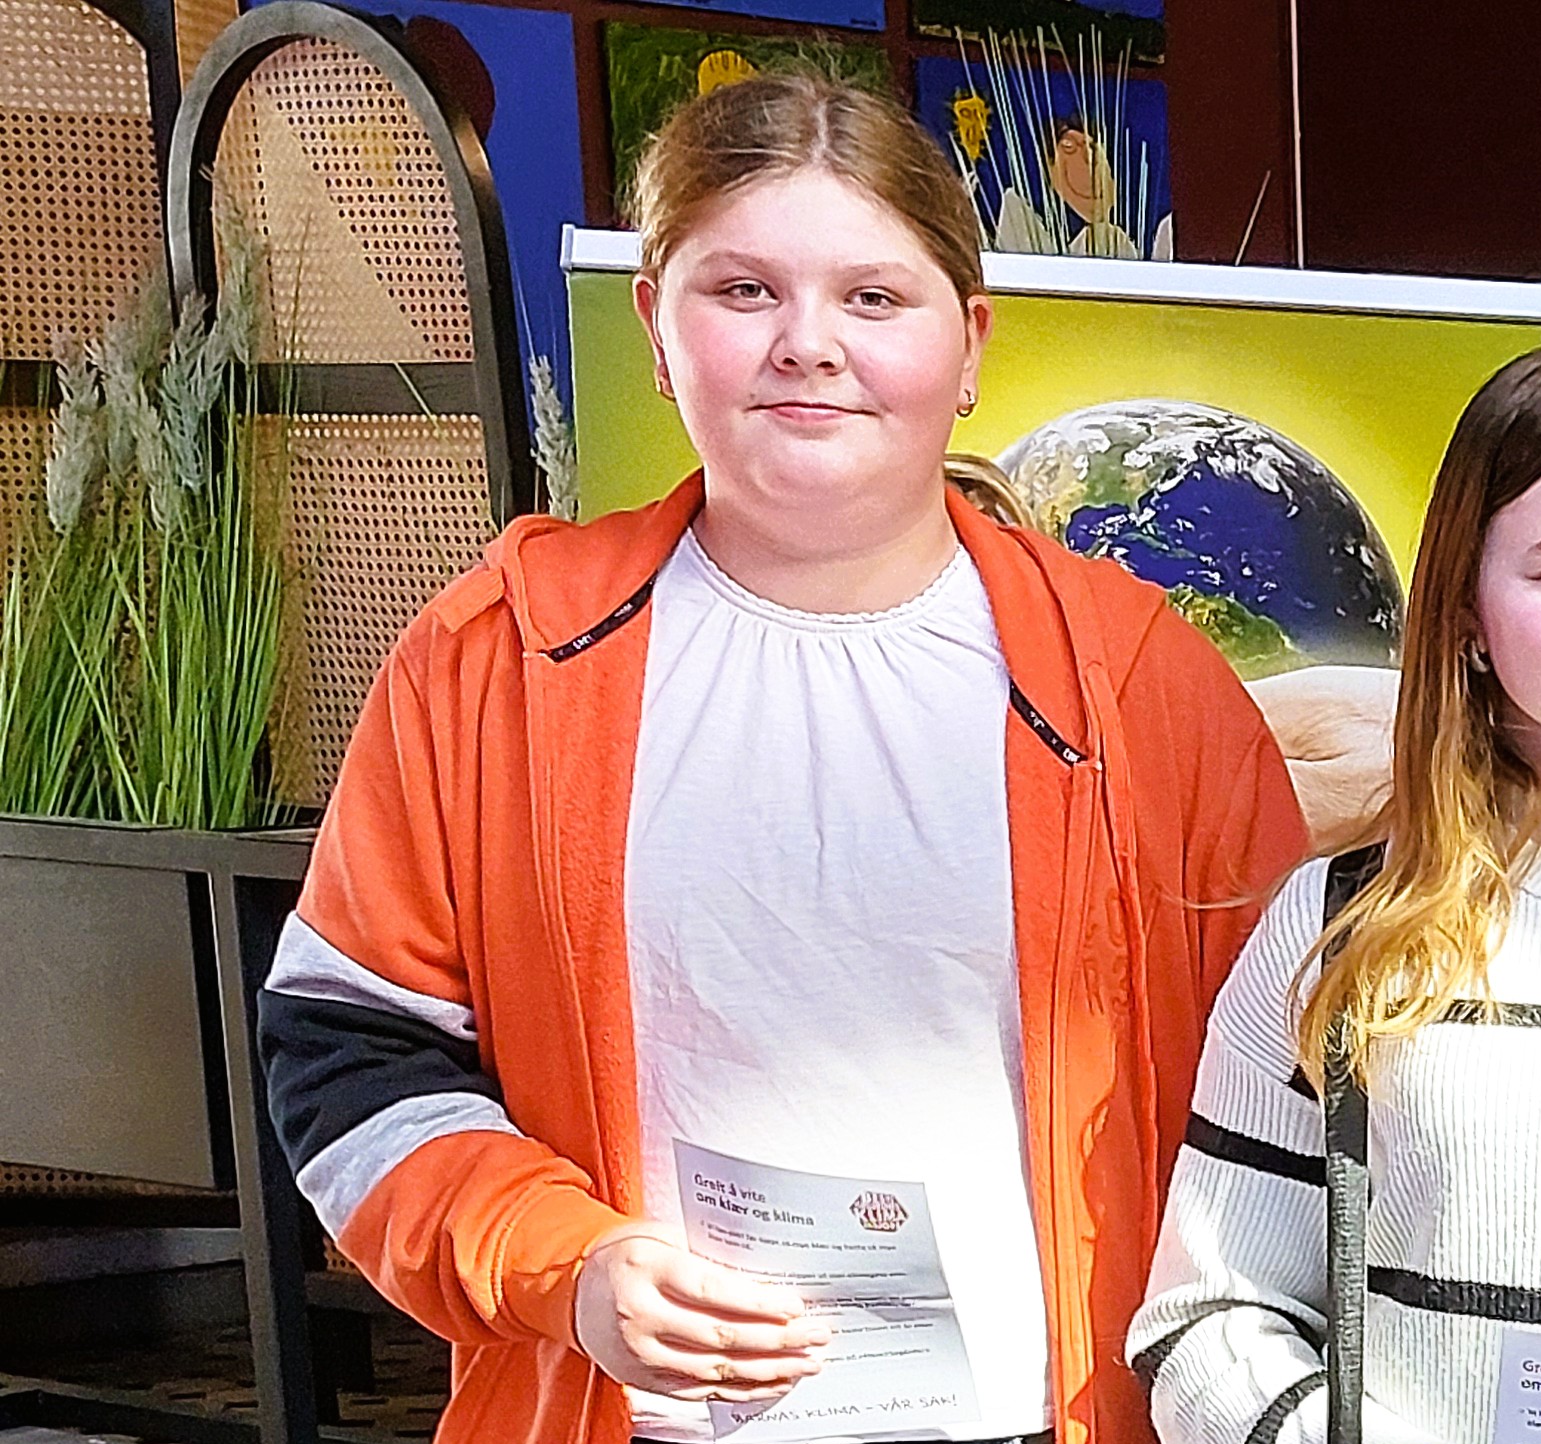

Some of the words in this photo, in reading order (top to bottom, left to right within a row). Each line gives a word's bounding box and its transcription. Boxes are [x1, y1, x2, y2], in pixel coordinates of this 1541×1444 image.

[696, 1192, 716, 1207] om
[752, 1209, 771, 1222] og
[773, 1208, 815, 1226] klima
[806, 1405, 861, 1420] KLIMA
[877, 1397, 914, 1413] VÅR
